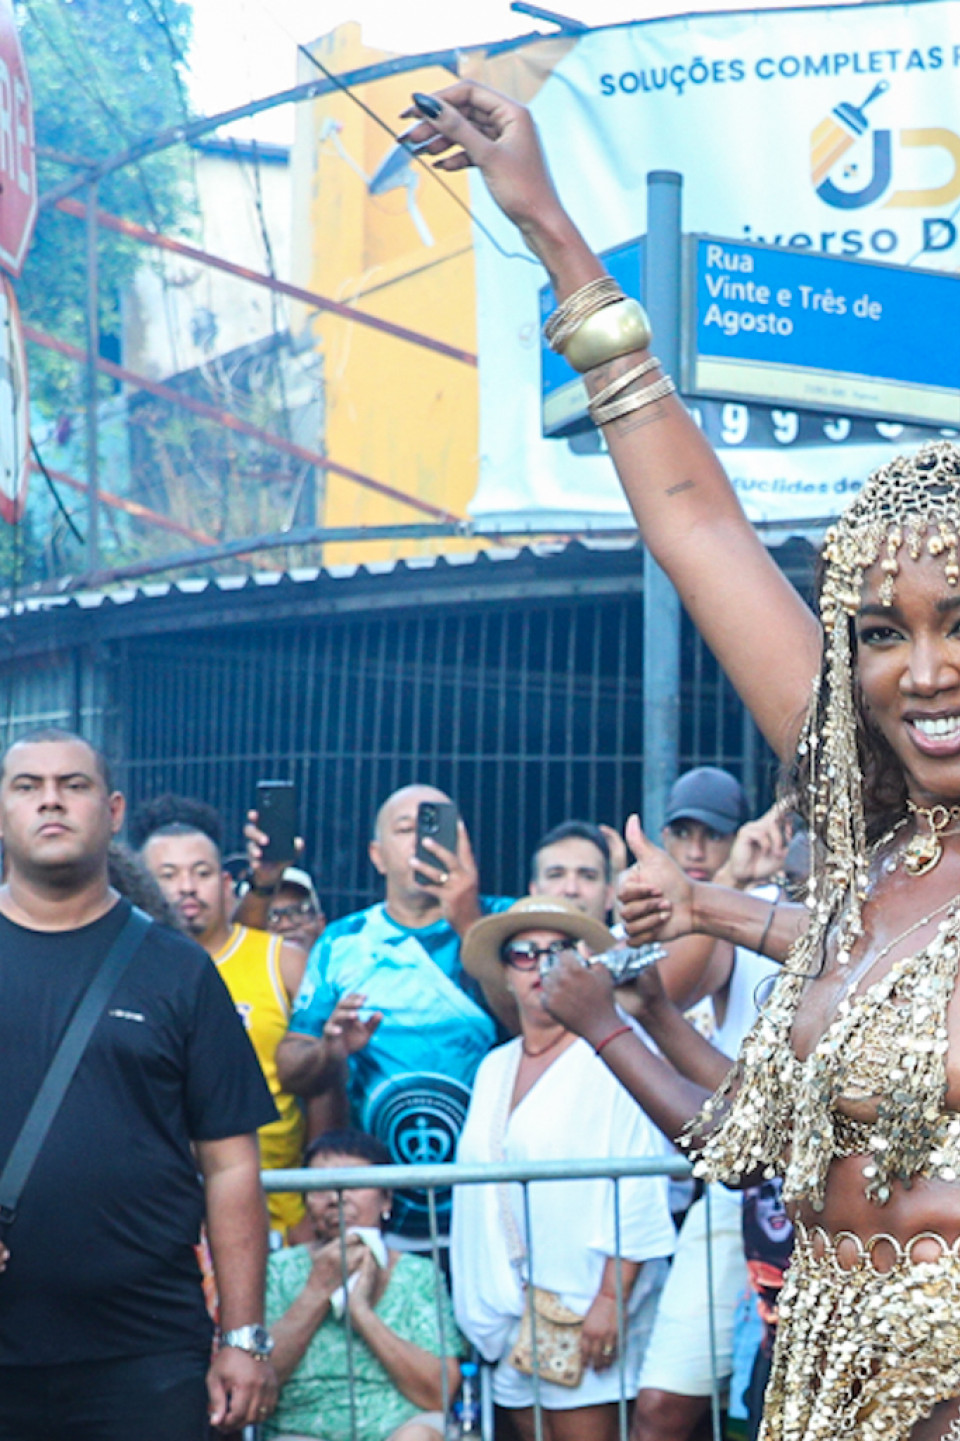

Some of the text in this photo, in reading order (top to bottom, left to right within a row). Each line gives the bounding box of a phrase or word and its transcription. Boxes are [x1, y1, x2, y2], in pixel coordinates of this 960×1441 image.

[600, 55, 745, 97] SOLUÇÕES
[754, 46, 944, 80] COMPLETAS
[706, 244, 754, 274] Rua
[704, 273, 883, 321] Vinte e Três de
[704, 303, 794, 336] Agosto
